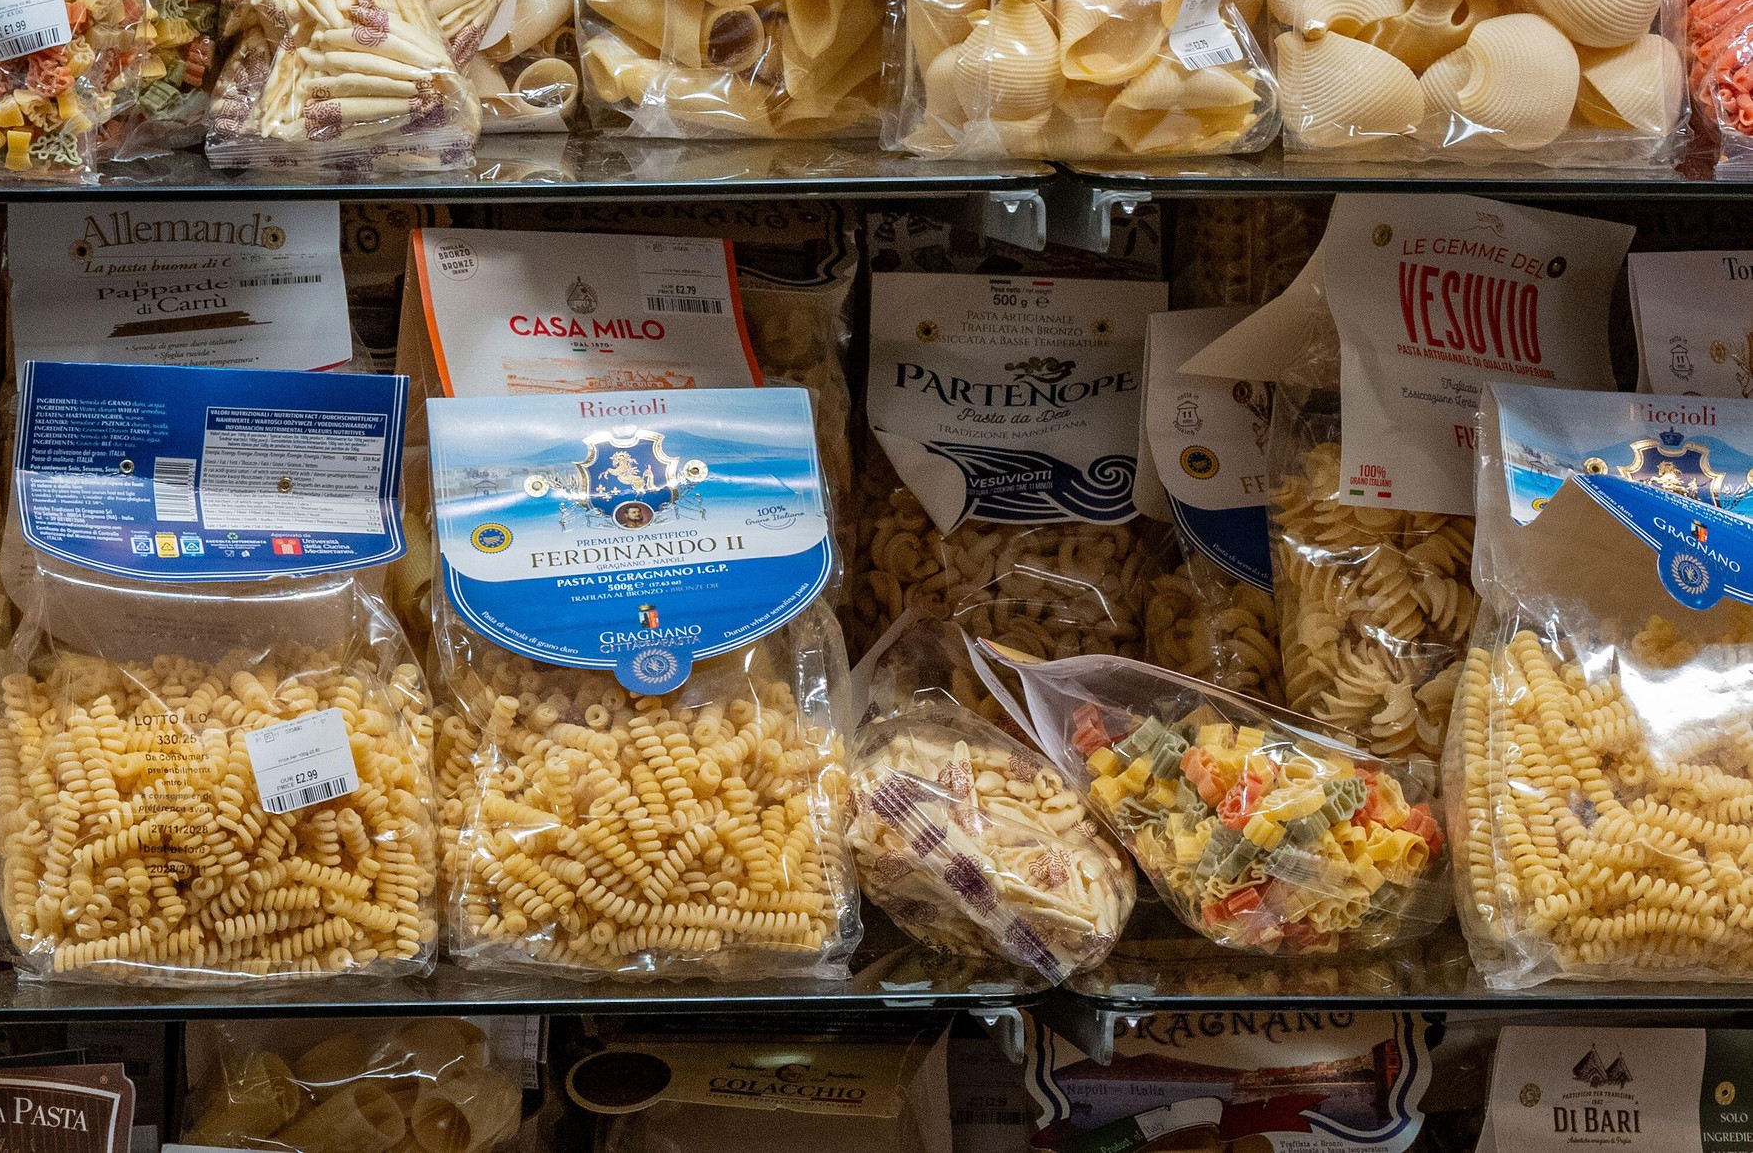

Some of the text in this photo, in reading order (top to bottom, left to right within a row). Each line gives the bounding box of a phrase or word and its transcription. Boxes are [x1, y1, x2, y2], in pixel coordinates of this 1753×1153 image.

[4, 21, 27, 35] £1.99
[81, 212, 274, 248] Allemandi
[676, 285, 696, 295] £2.79
[993, 295, 1017, 306] 500
[1398, 261, 1542, 363] VESUVIO
[509, 316, 665, 340] CASA MILO
[896, 362, 1138, 407] PARTENOPE
[578, 397, 667, 419] Riccioli
[969, 470, 1052, 488] VESUVIOTTI
[1653, 516, 1740, 573] GRAGNANO
[296, 769, 318, 782] £2.99
[12, 1096, 89, 1131] PASTA
[1553, 1107, 1639, 1134] DI BARI
